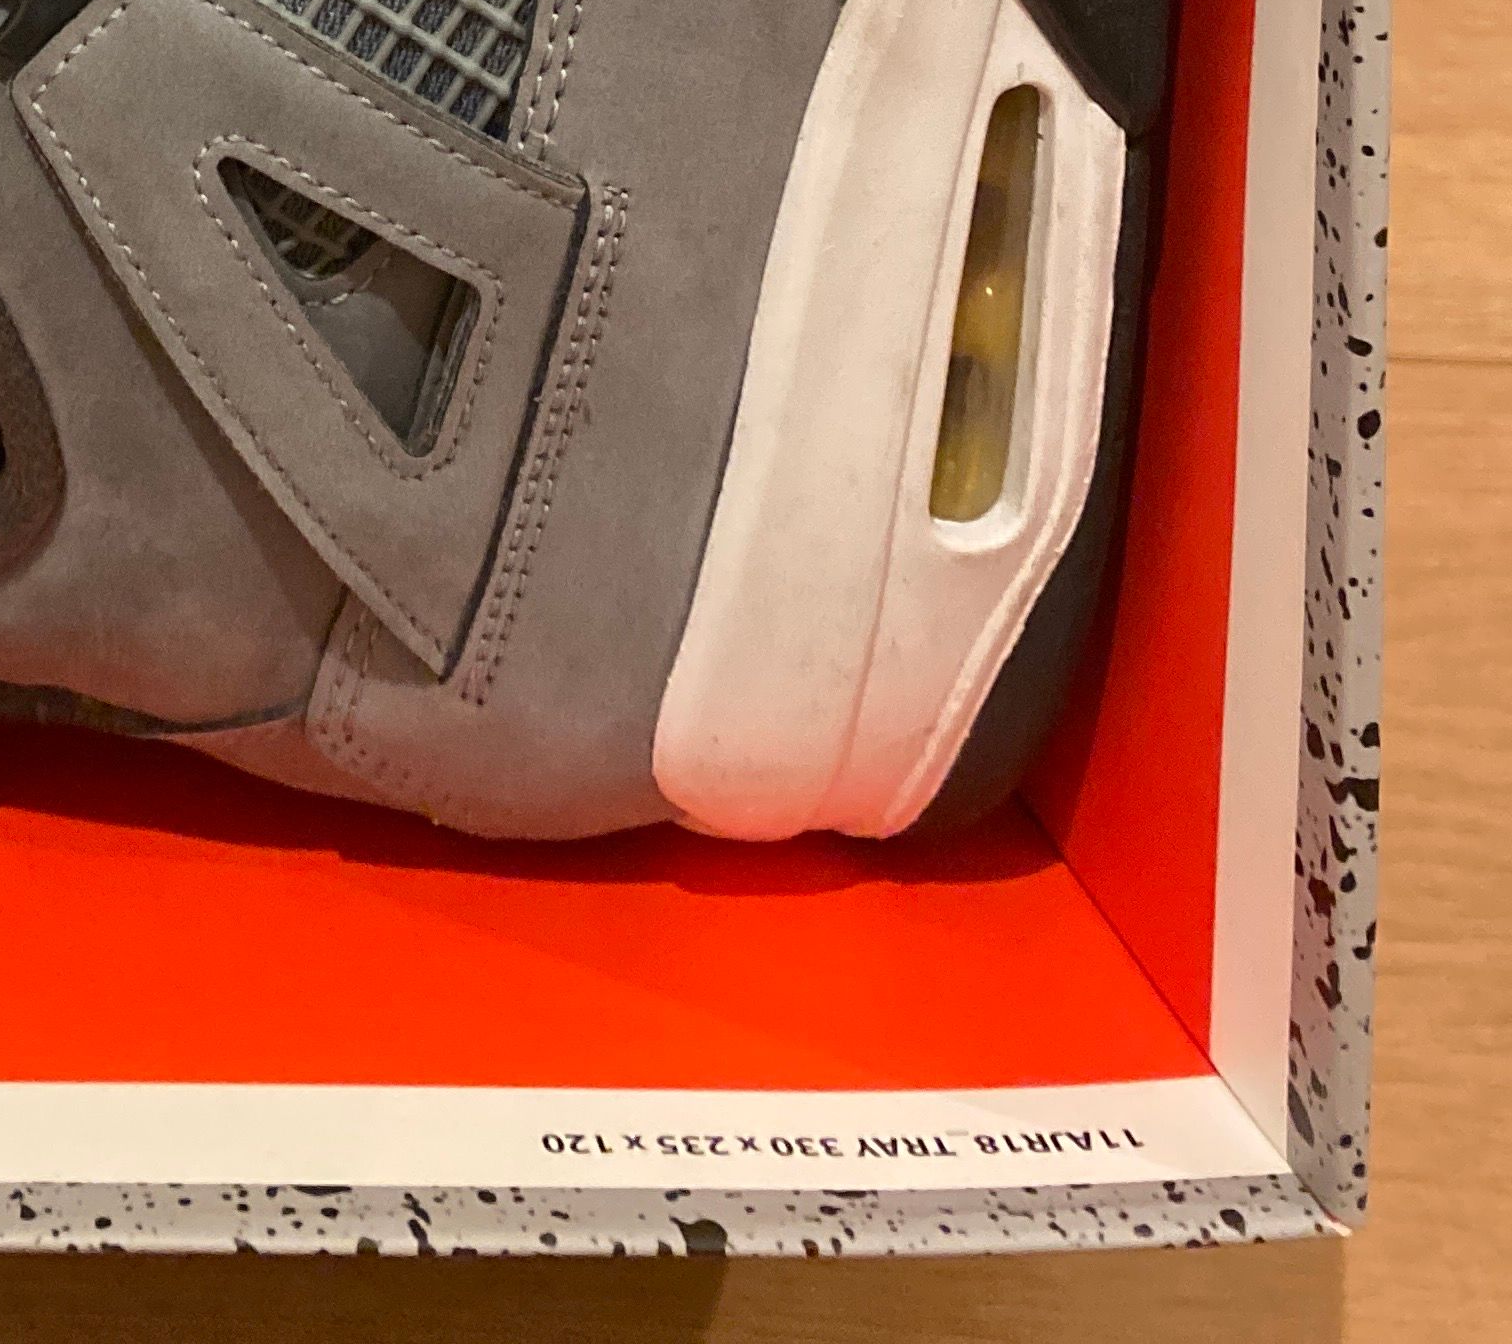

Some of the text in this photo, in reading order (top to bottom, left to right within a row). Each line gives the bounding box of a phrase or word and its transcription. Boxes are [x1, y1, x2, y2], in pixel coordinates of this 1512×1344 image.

[540, 1133, 614, 1155] 120
[622, 1134, 647, 1151] x
[655, 1134, 730, 1157] 235
[736, 1136, 761, 1153] x
[769, 1136, 844, 1158] 330
